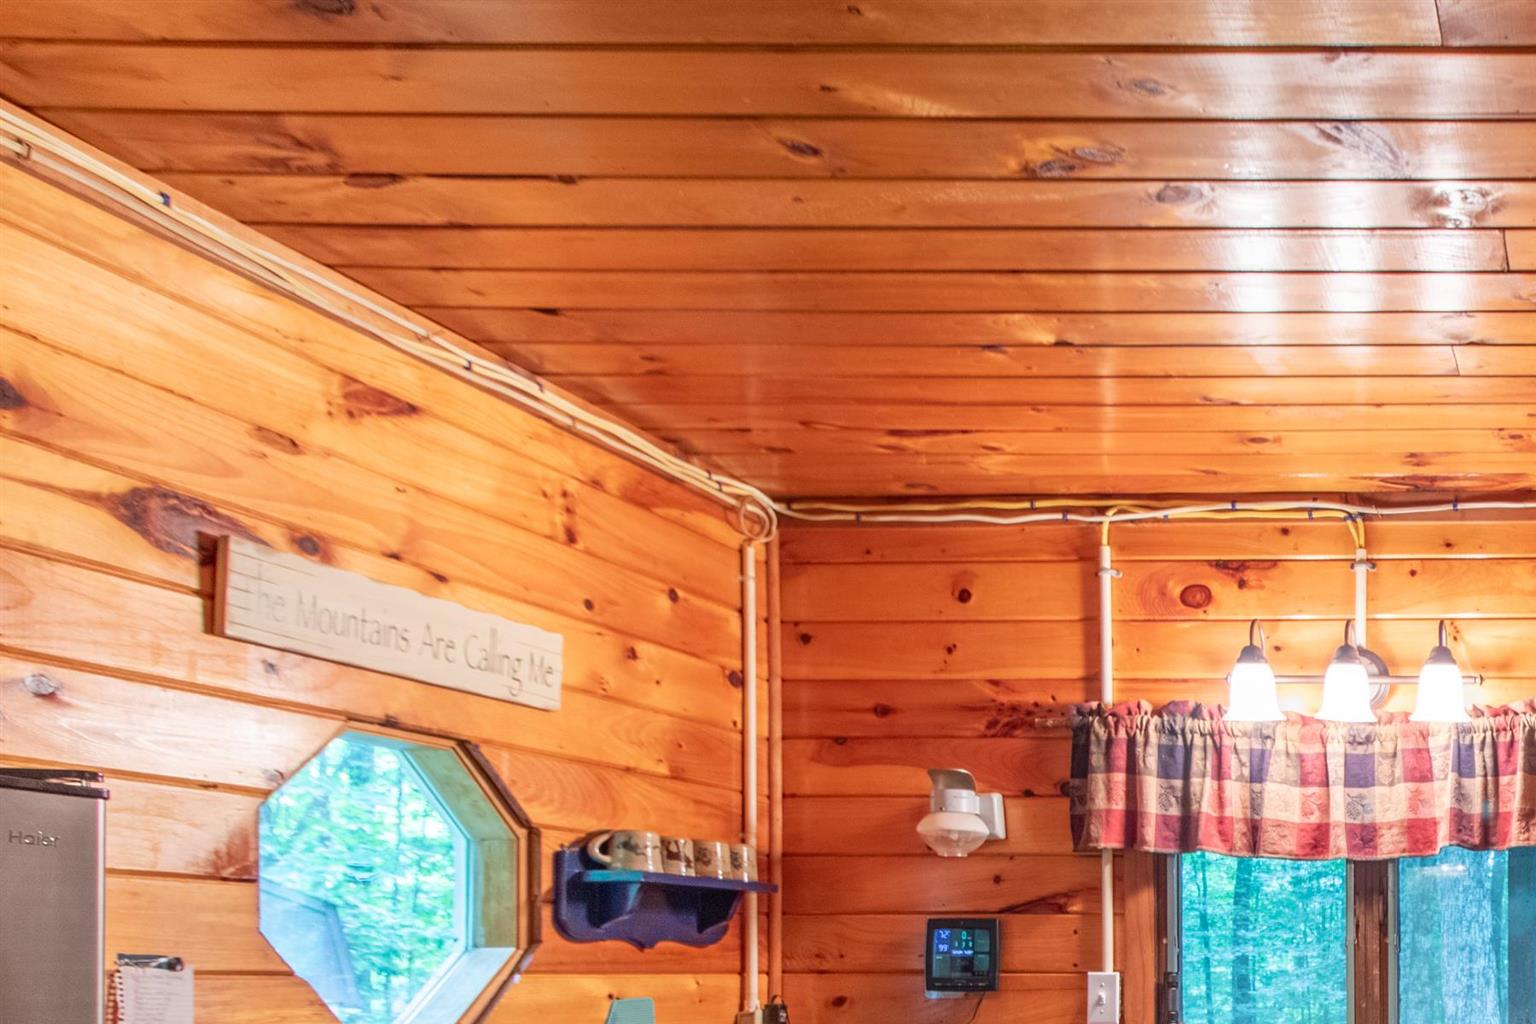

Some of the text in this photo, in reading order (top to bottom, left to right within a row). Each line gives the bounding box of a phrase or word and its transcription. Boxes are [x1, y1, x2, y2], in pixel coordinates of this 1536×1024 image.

[297, 590, 411, 653] Mountains
[418, 622, 457, 664] Are
[463, 627, 523, 697] Calling
[528, 652, 554, 688] Me
[8, 829, 60, 848] Haier
